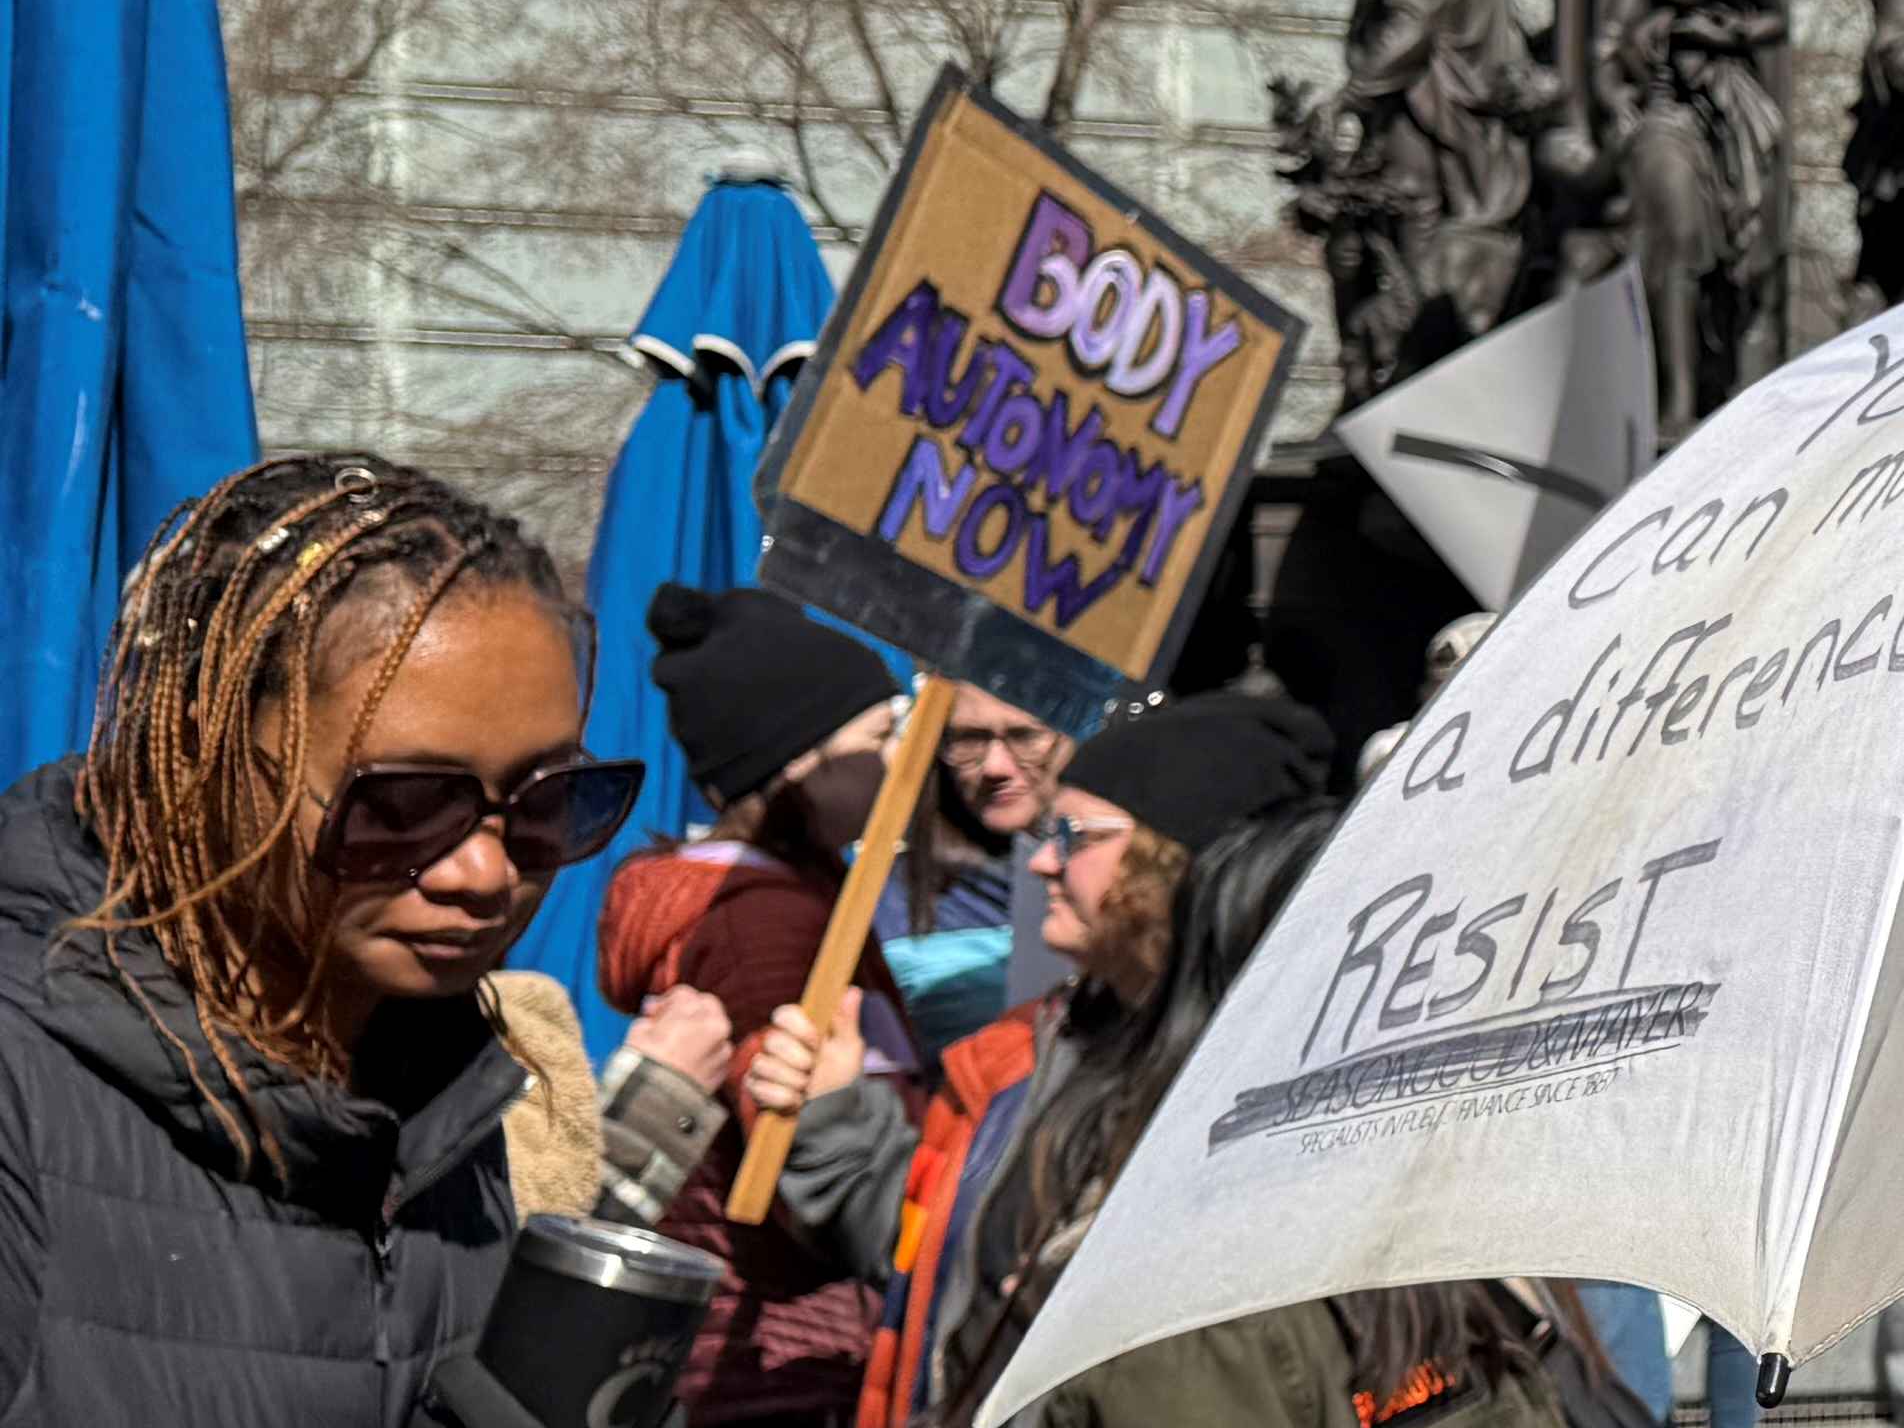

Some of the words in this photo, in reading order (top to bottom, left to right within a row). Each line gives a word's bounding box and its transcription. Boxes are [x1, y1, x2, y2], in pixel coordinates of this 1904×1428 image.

[999, 189, 1242, 439] BODY
[853, 281, 1201, 588] AUTONOMY
[880, 436, 1130, 628] NOW
[1401, 700, 1470, 802] a
[1301, 837, 1722, 1062] RESIST
